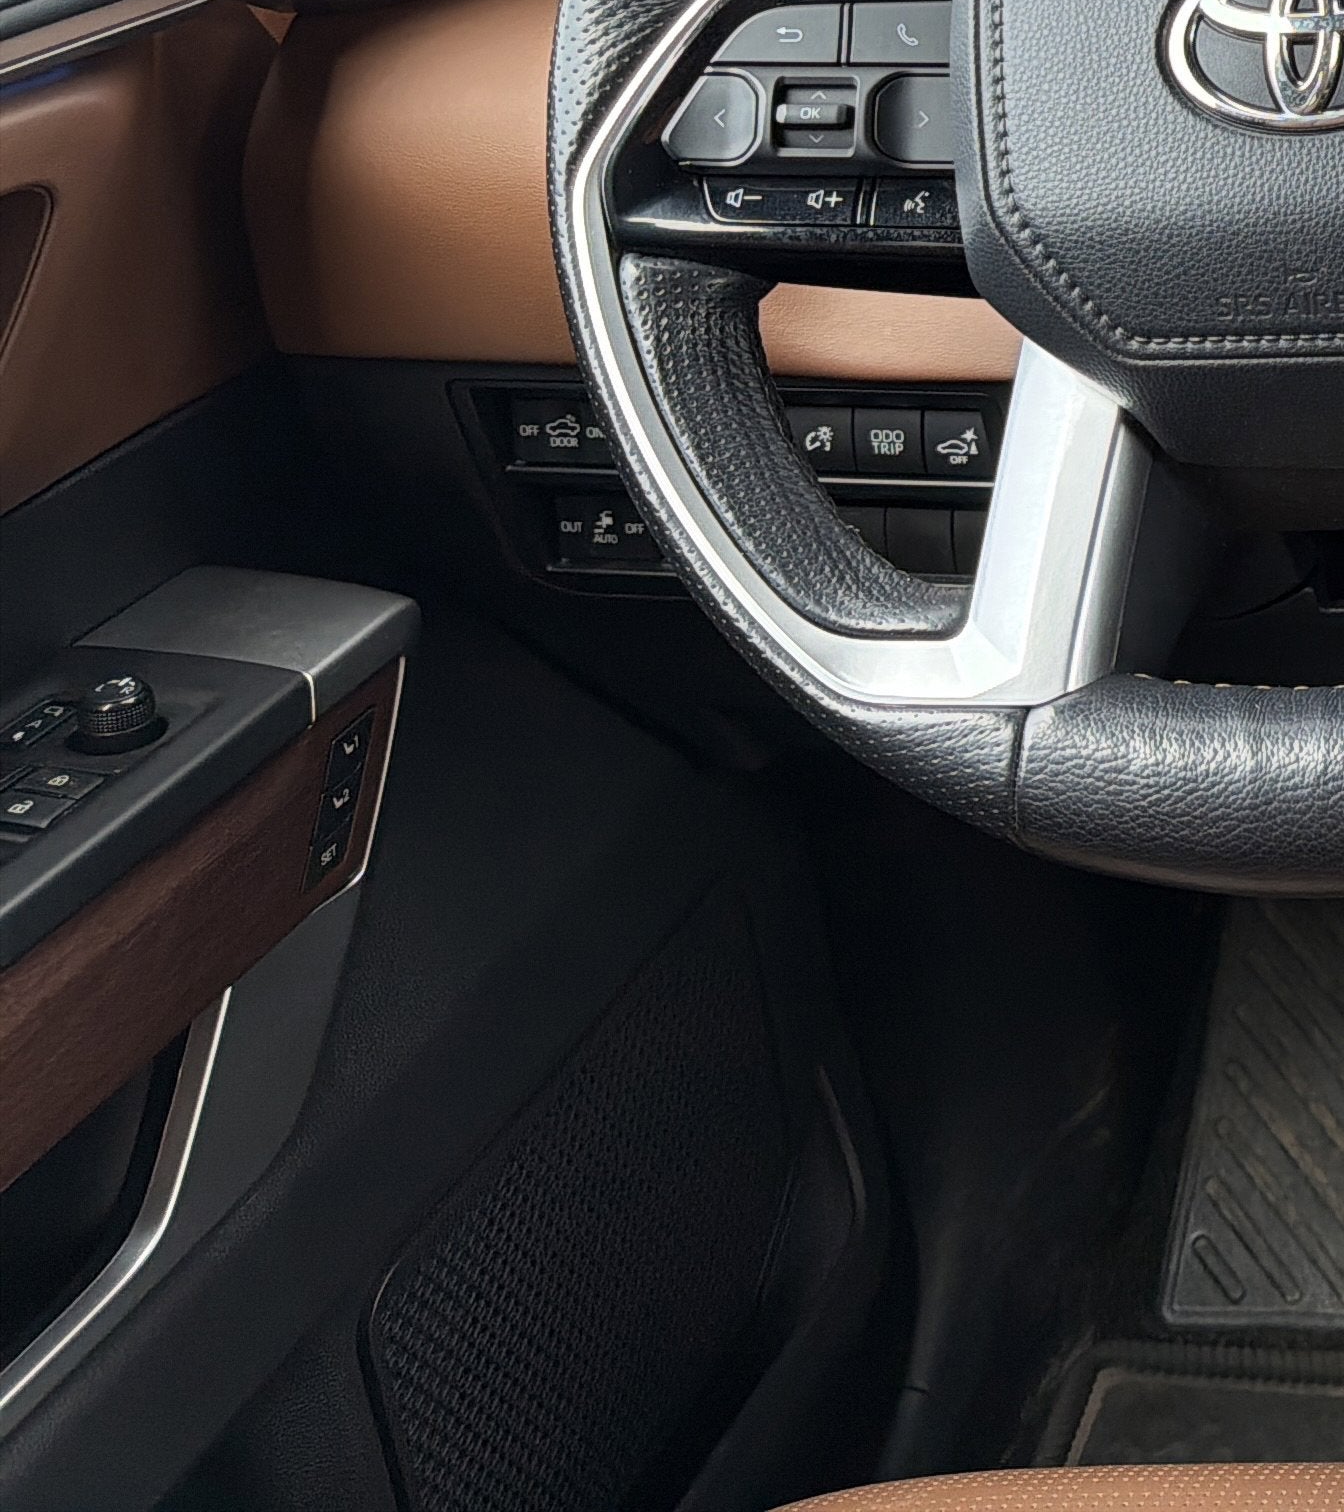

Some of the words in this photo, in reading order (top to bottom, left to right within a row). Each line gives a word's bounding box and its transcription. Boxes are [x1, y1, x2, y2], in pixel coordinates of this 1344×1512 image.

[799, 107, 821, 120] OK
[519, 424, 541, 437] OFF
[870, 429, 905, 445] ODO
[549, 437, 579, 448] DOOR
[871, 442, 905, 457] TRIP
[949, 455, 969, 465] OFF
[560, 520, 583, 533] OUT
[624, 522, 645, 535] OFF
[593, 533, 619, 545] AUTO
[319, 843, 338, 866] SET
